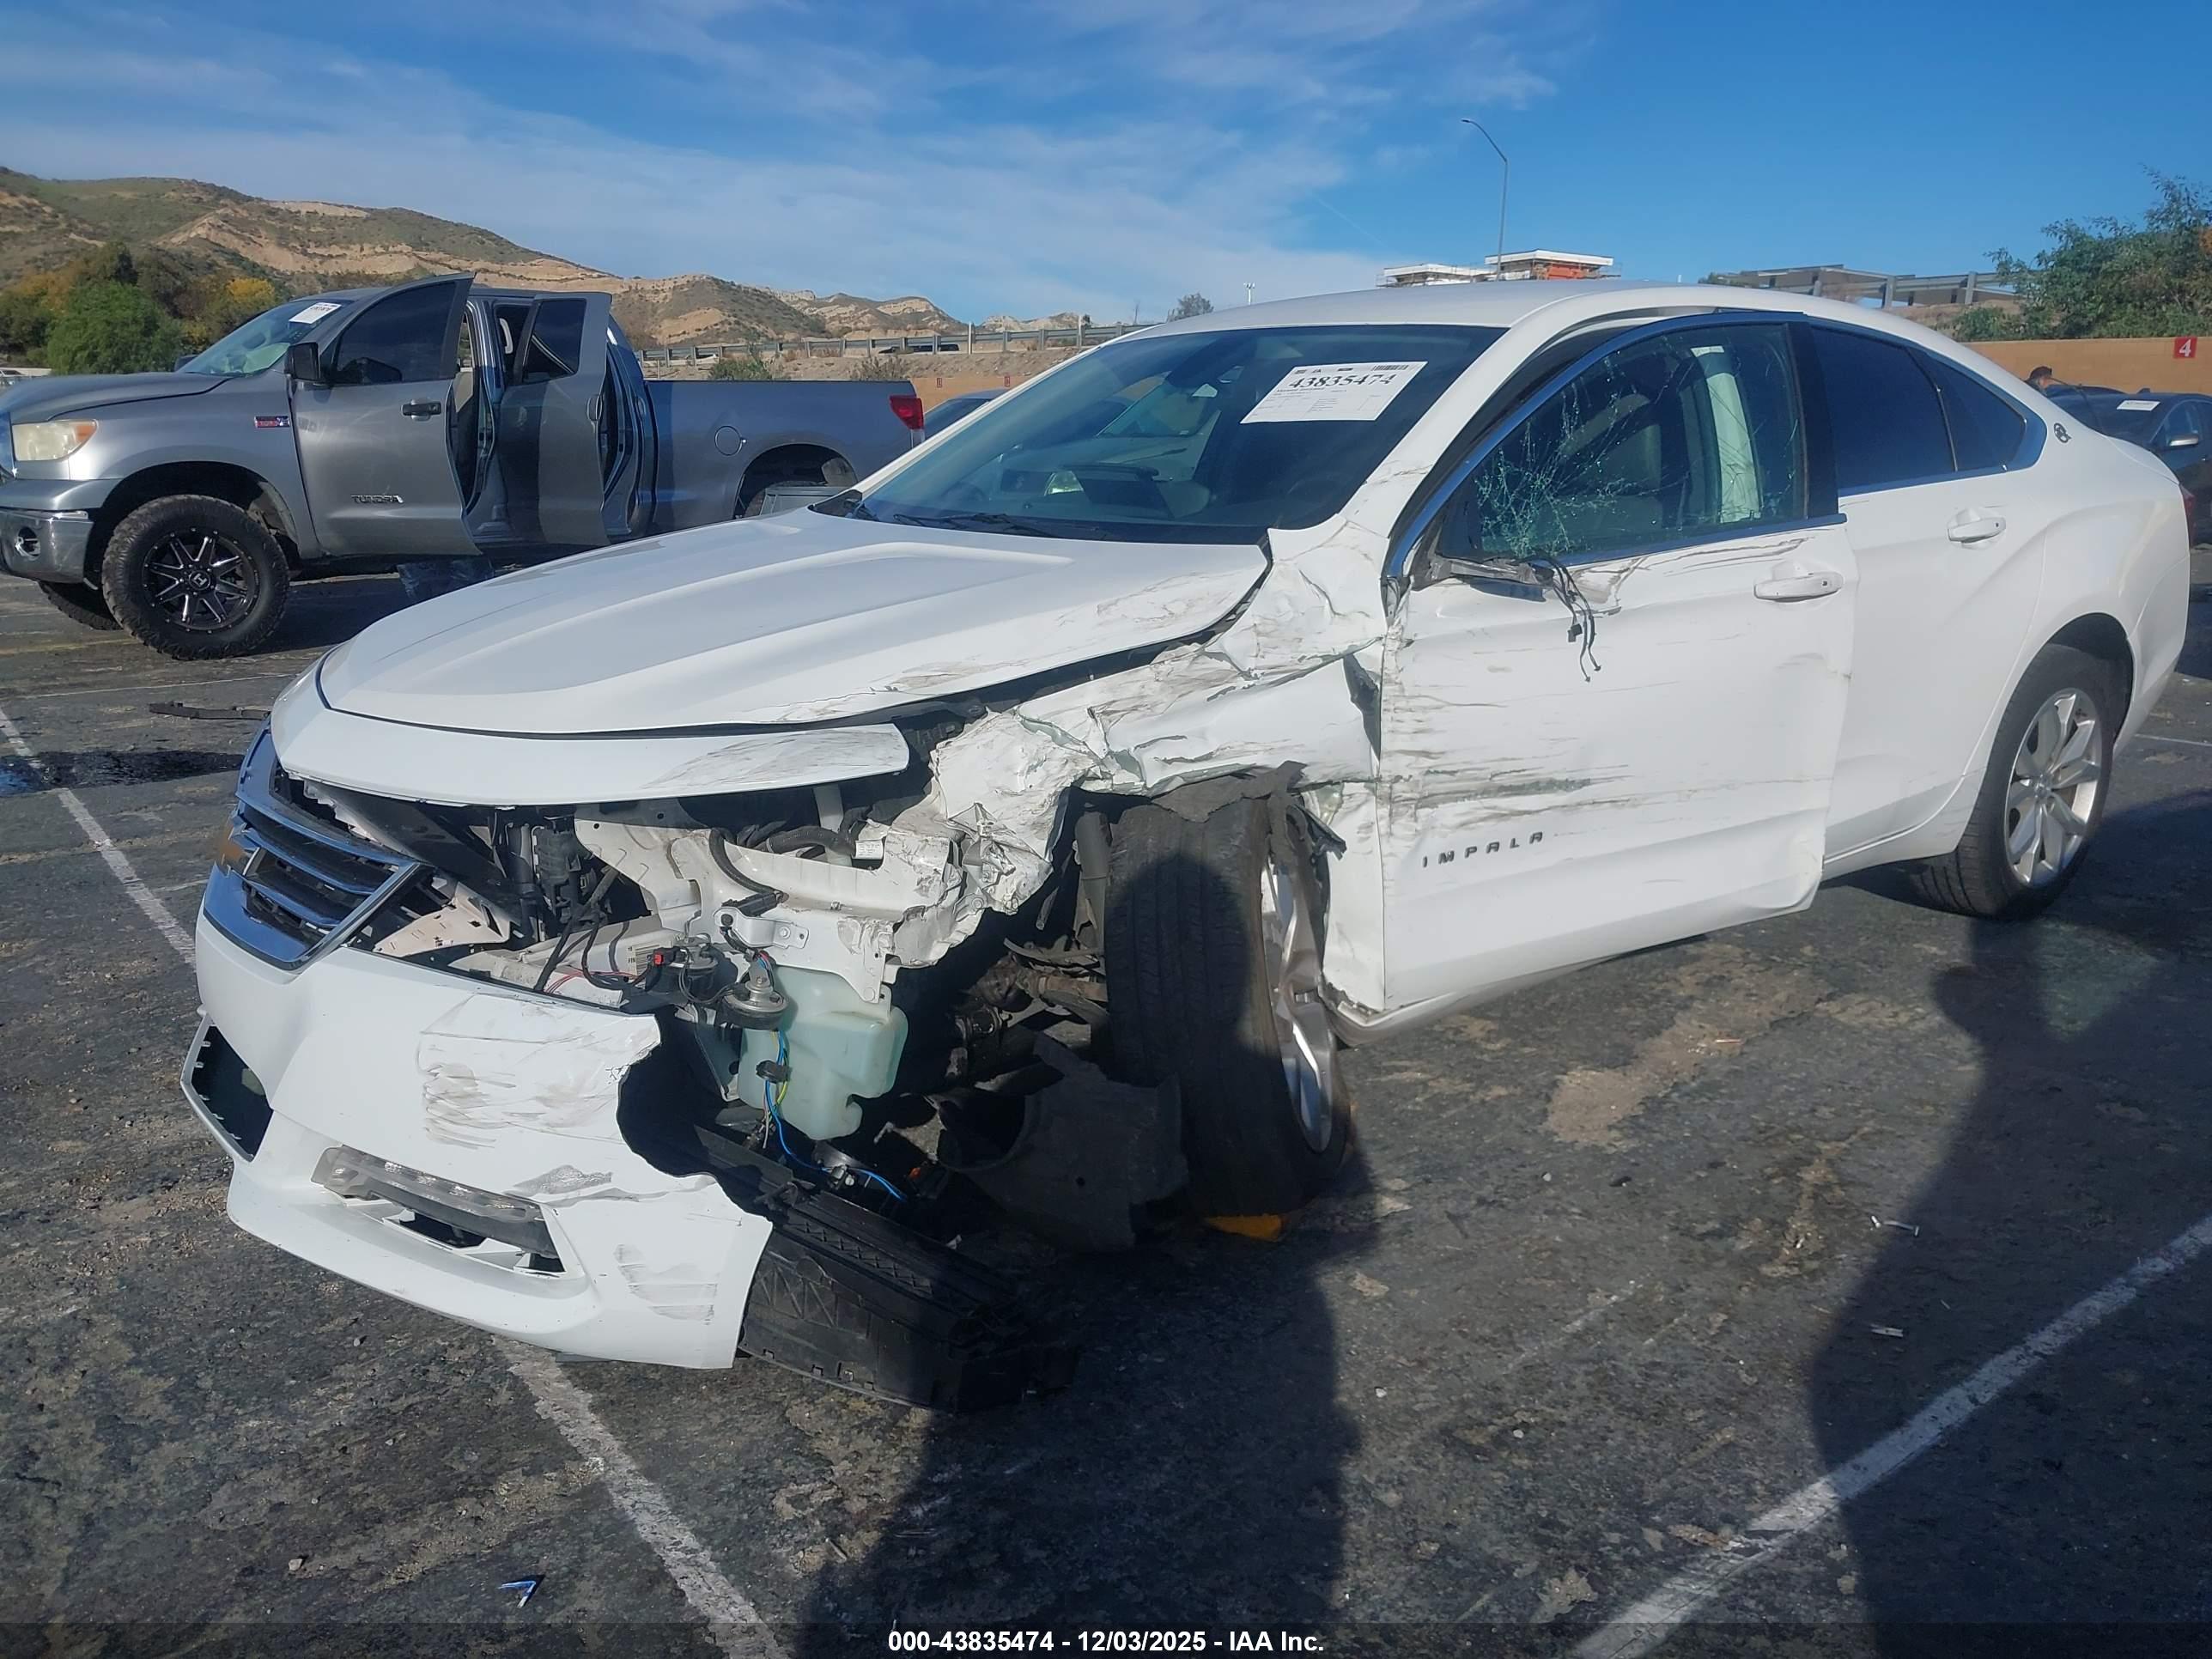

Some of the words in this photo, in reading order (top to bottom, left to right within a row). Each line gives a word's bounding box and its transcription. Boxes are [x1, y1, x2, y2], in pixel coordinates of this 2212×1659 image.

[2179, 338, 2191, 356] 4
[1289, 374, 1396, 388] 43835474
[1422, 831, 1543, 868] IMPALA
